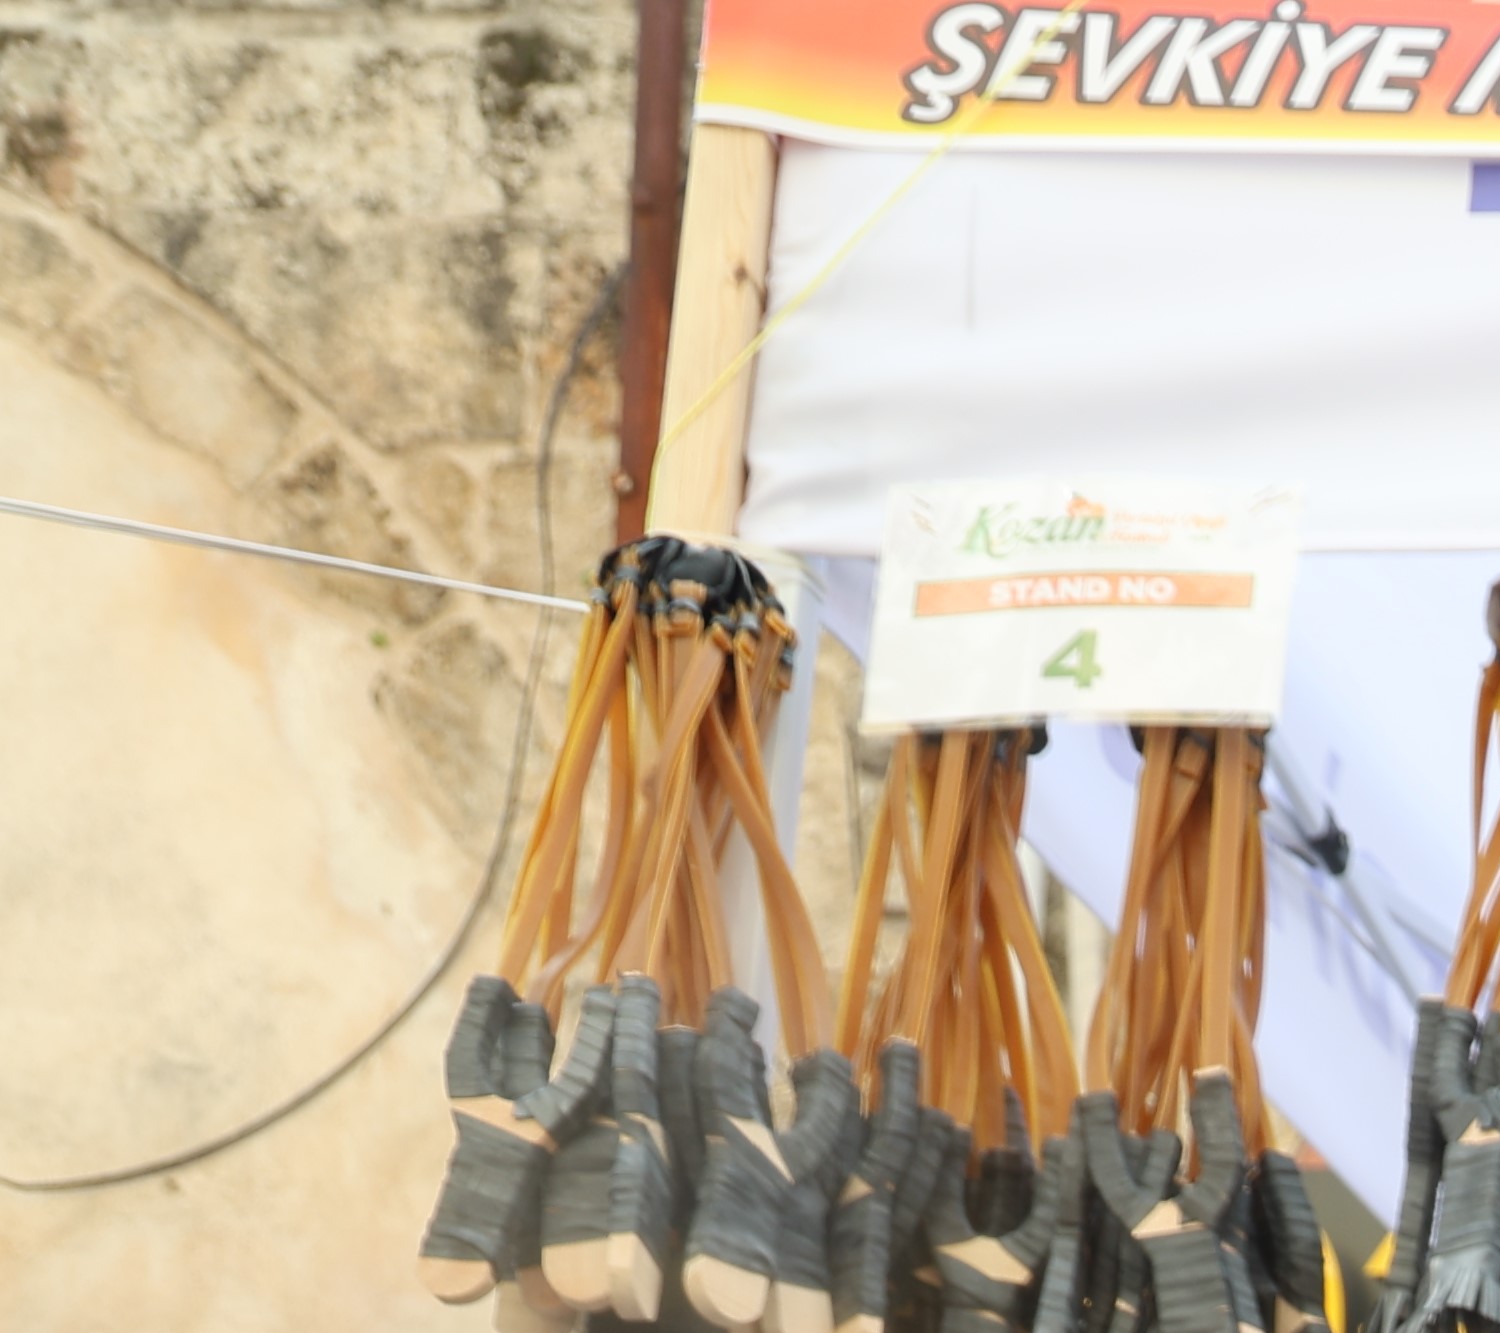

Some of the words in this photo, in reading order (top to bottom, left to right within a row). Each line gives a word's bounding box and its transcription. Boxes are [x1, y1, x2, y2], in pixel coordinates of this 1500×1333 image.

[904, 0, 1446, 125] ŞEVKİYE
[988, 575, 1112, 606] STAND
[1118, 574, 1177, 604] NO
[1041, 628, 1104, 690] 4
